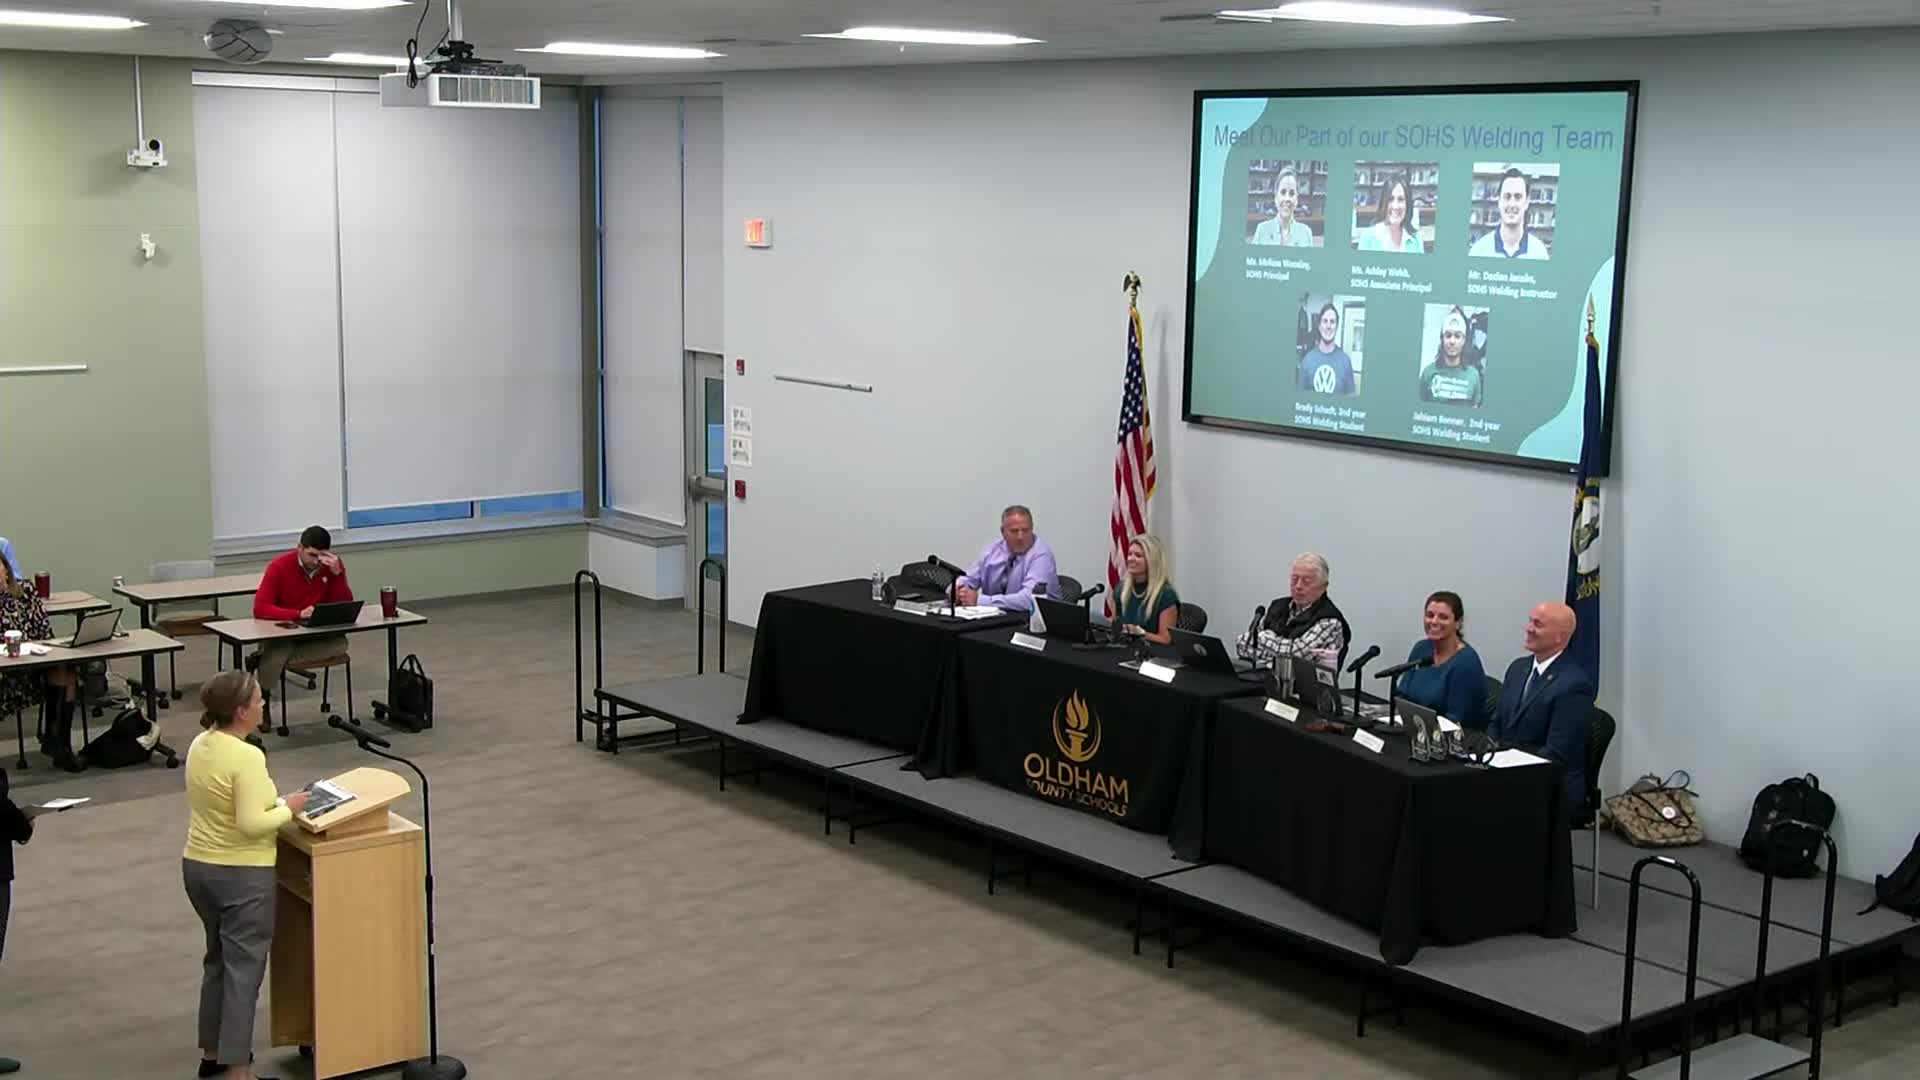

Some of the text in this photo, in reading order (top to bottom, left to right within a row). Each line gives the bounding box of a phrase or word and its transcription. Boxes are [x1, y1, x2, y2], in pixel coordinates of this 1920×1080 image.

[1215, 125, 1614, 155] Meet Our Part of our SOHS Welding Team
[1263, 270, 1290, 282] Principal
[1350, 278, 1369, 288] SOHS
[1402, 281, 1433, 293] Principal
[1467, 284, 1558, 299] SOHS Welding Instructor
[1469, 418, 1483, 429] 2nd
[1484, 422, 1501, 432] year
[1432, 428, 1461, 442] Welding
[1462, 431, 1490, 443] Student
[1024, 753, 1129, 803] OLDHAM
